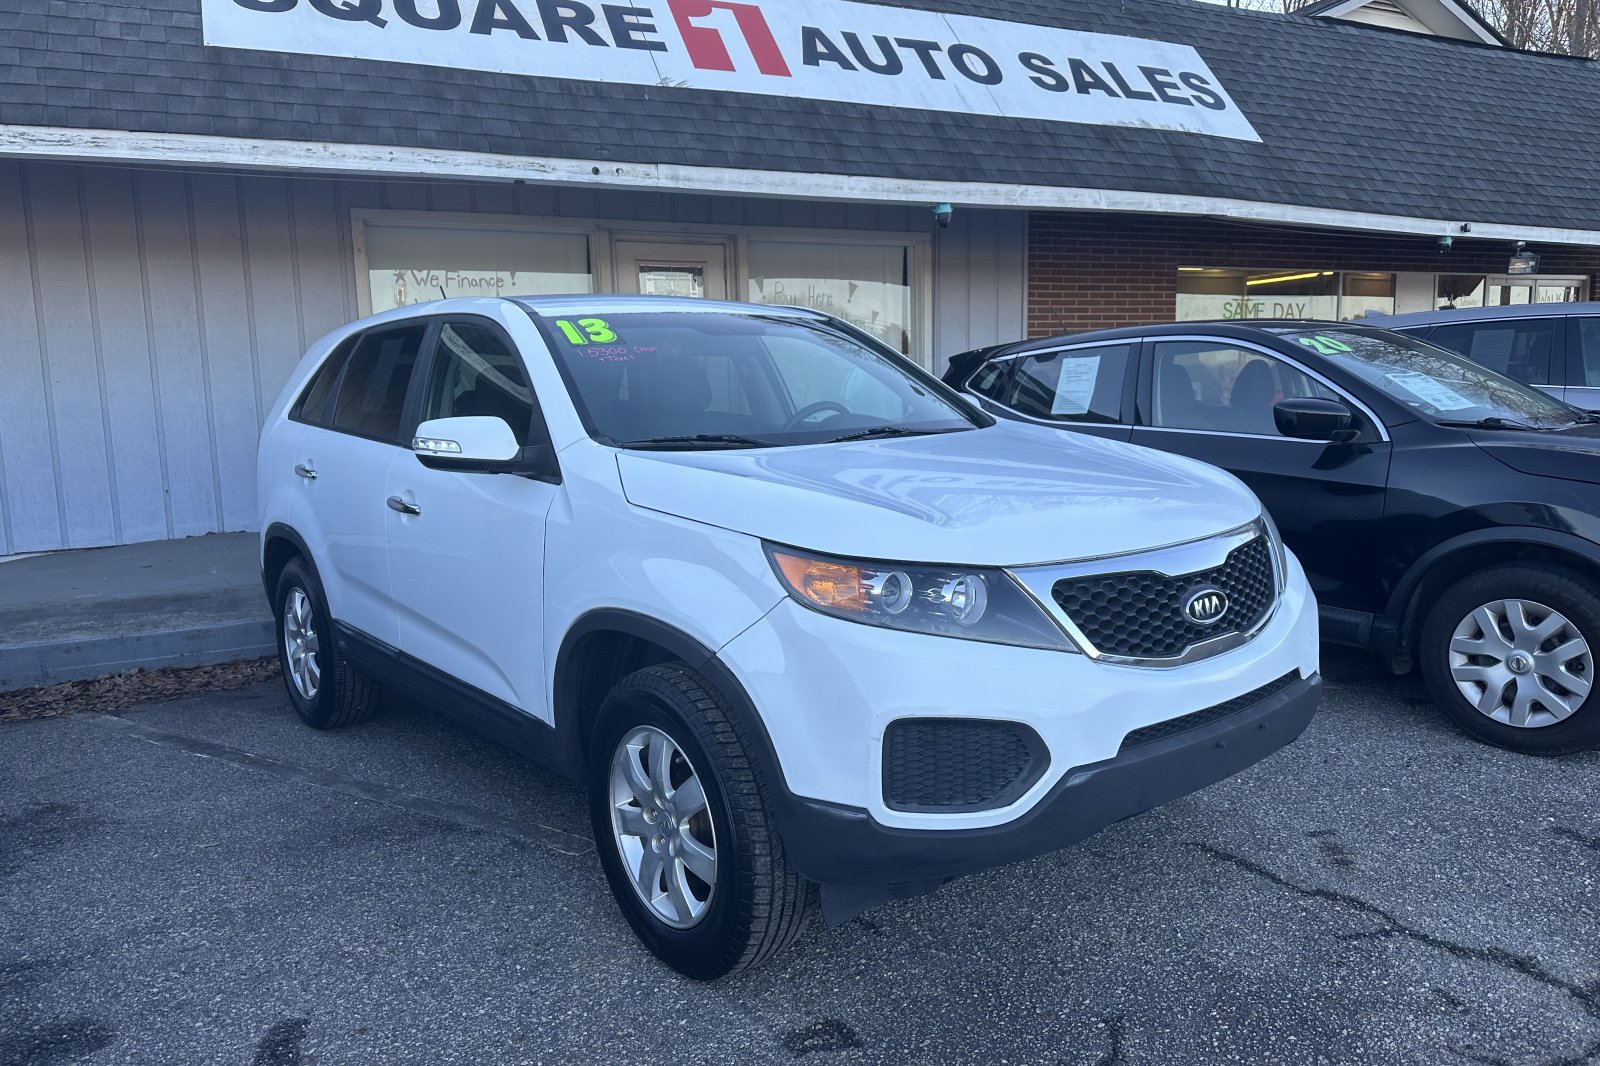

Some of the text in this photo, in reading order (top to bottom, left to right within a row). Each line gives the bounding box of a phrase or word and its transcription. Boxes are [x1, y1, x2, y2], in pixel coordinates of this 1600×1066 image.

[684, 3, 769, 76] 1
[801, 25, 1003, 86] AUTO
[1018, 51, 1227, 111] SALES
[410, 269, 440, 288] We
[808, 285, 833, 308] Here
[1222, 301, 1306, 319] SAME DAY
[555, 318, 618, 345] 13
[1298, 335, 1353, 356] 20
[1193, 595, 1221, 618] KIA
